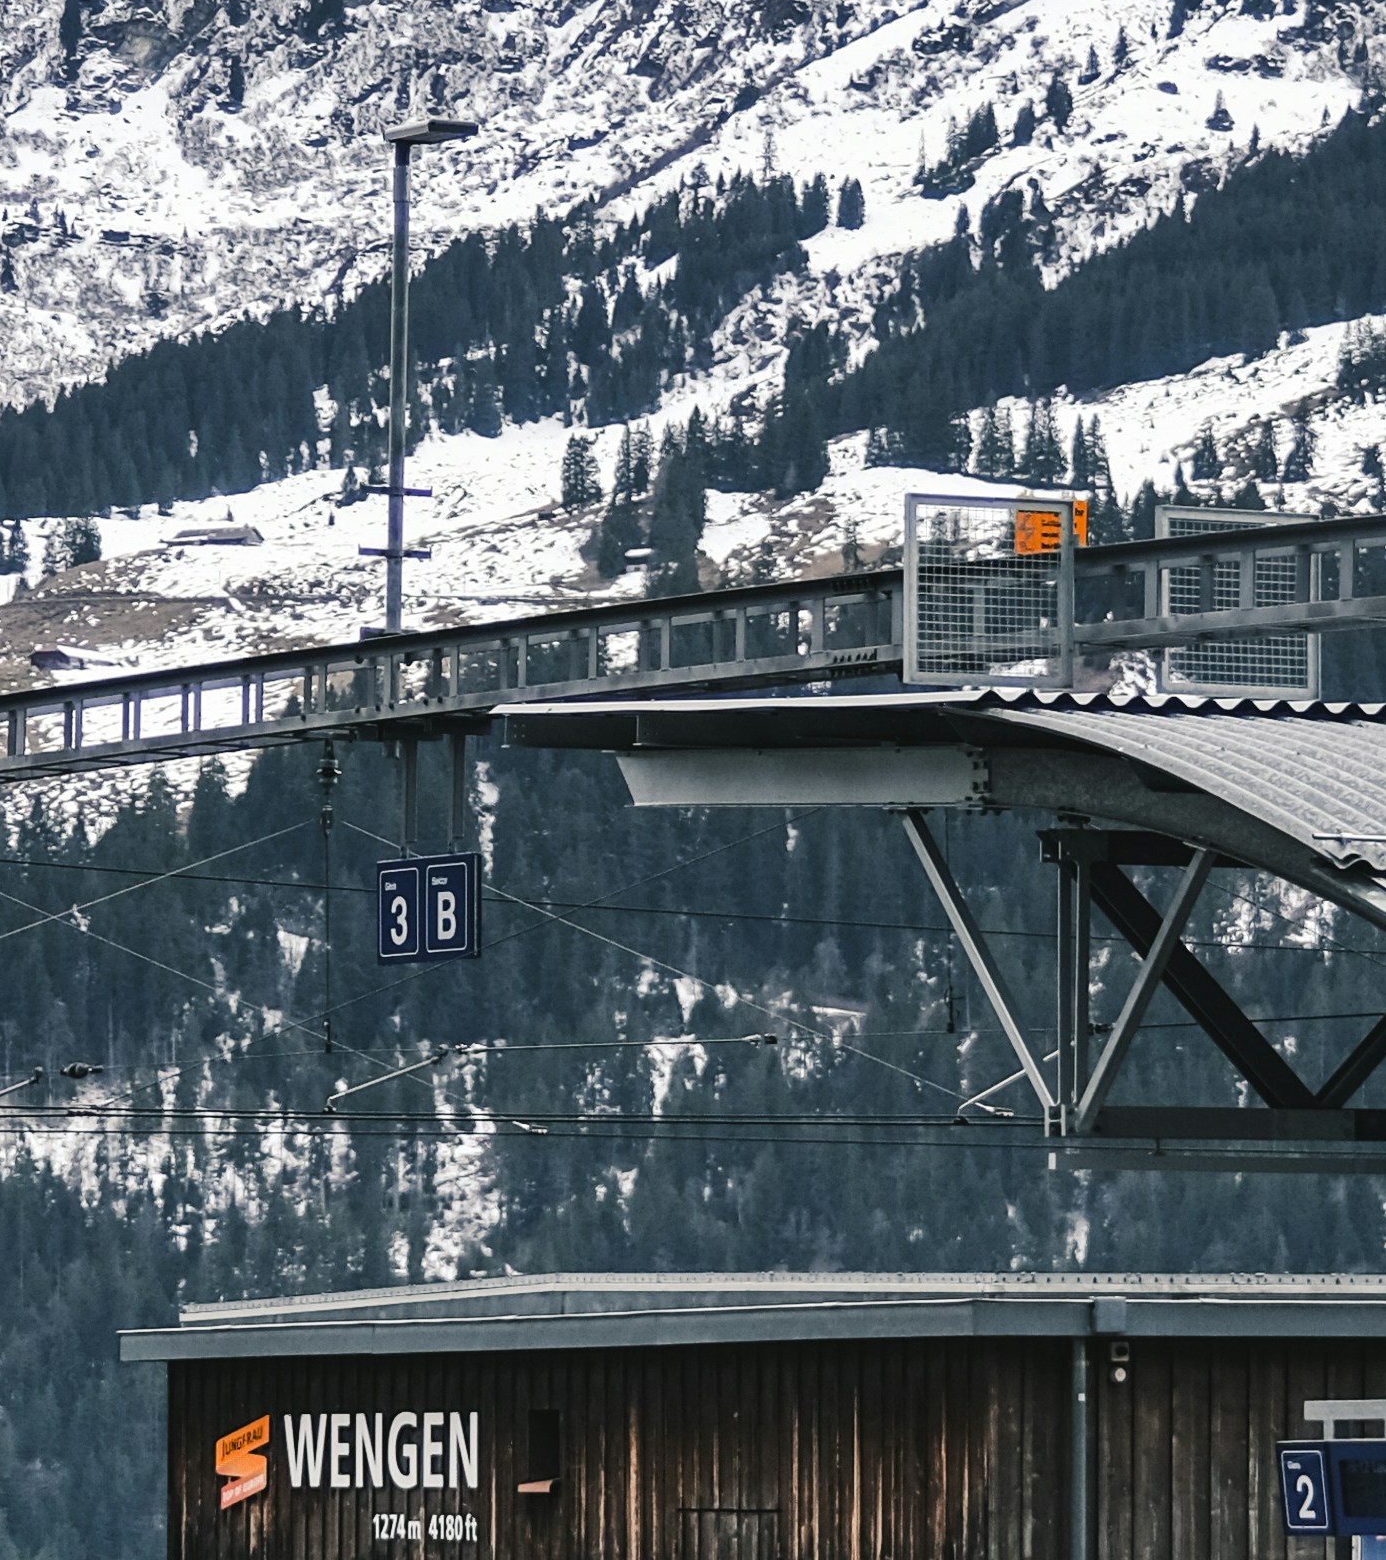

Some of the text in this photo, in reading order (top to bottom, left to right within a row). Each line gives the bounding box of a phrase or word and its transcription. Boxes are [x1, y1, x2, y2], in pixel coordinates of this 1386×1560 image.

[390, 895, 408, 946] 3
[437, 891, 457, 940] B
[283, 1411, 478, 1489] WENGEN
[1296, 1474, 1317, 1519] 2
[373, 1513, 406, 1539] 1274
[428, 1513, 463, 1541] 4180
[464, 1513, 478, 1541] ft
